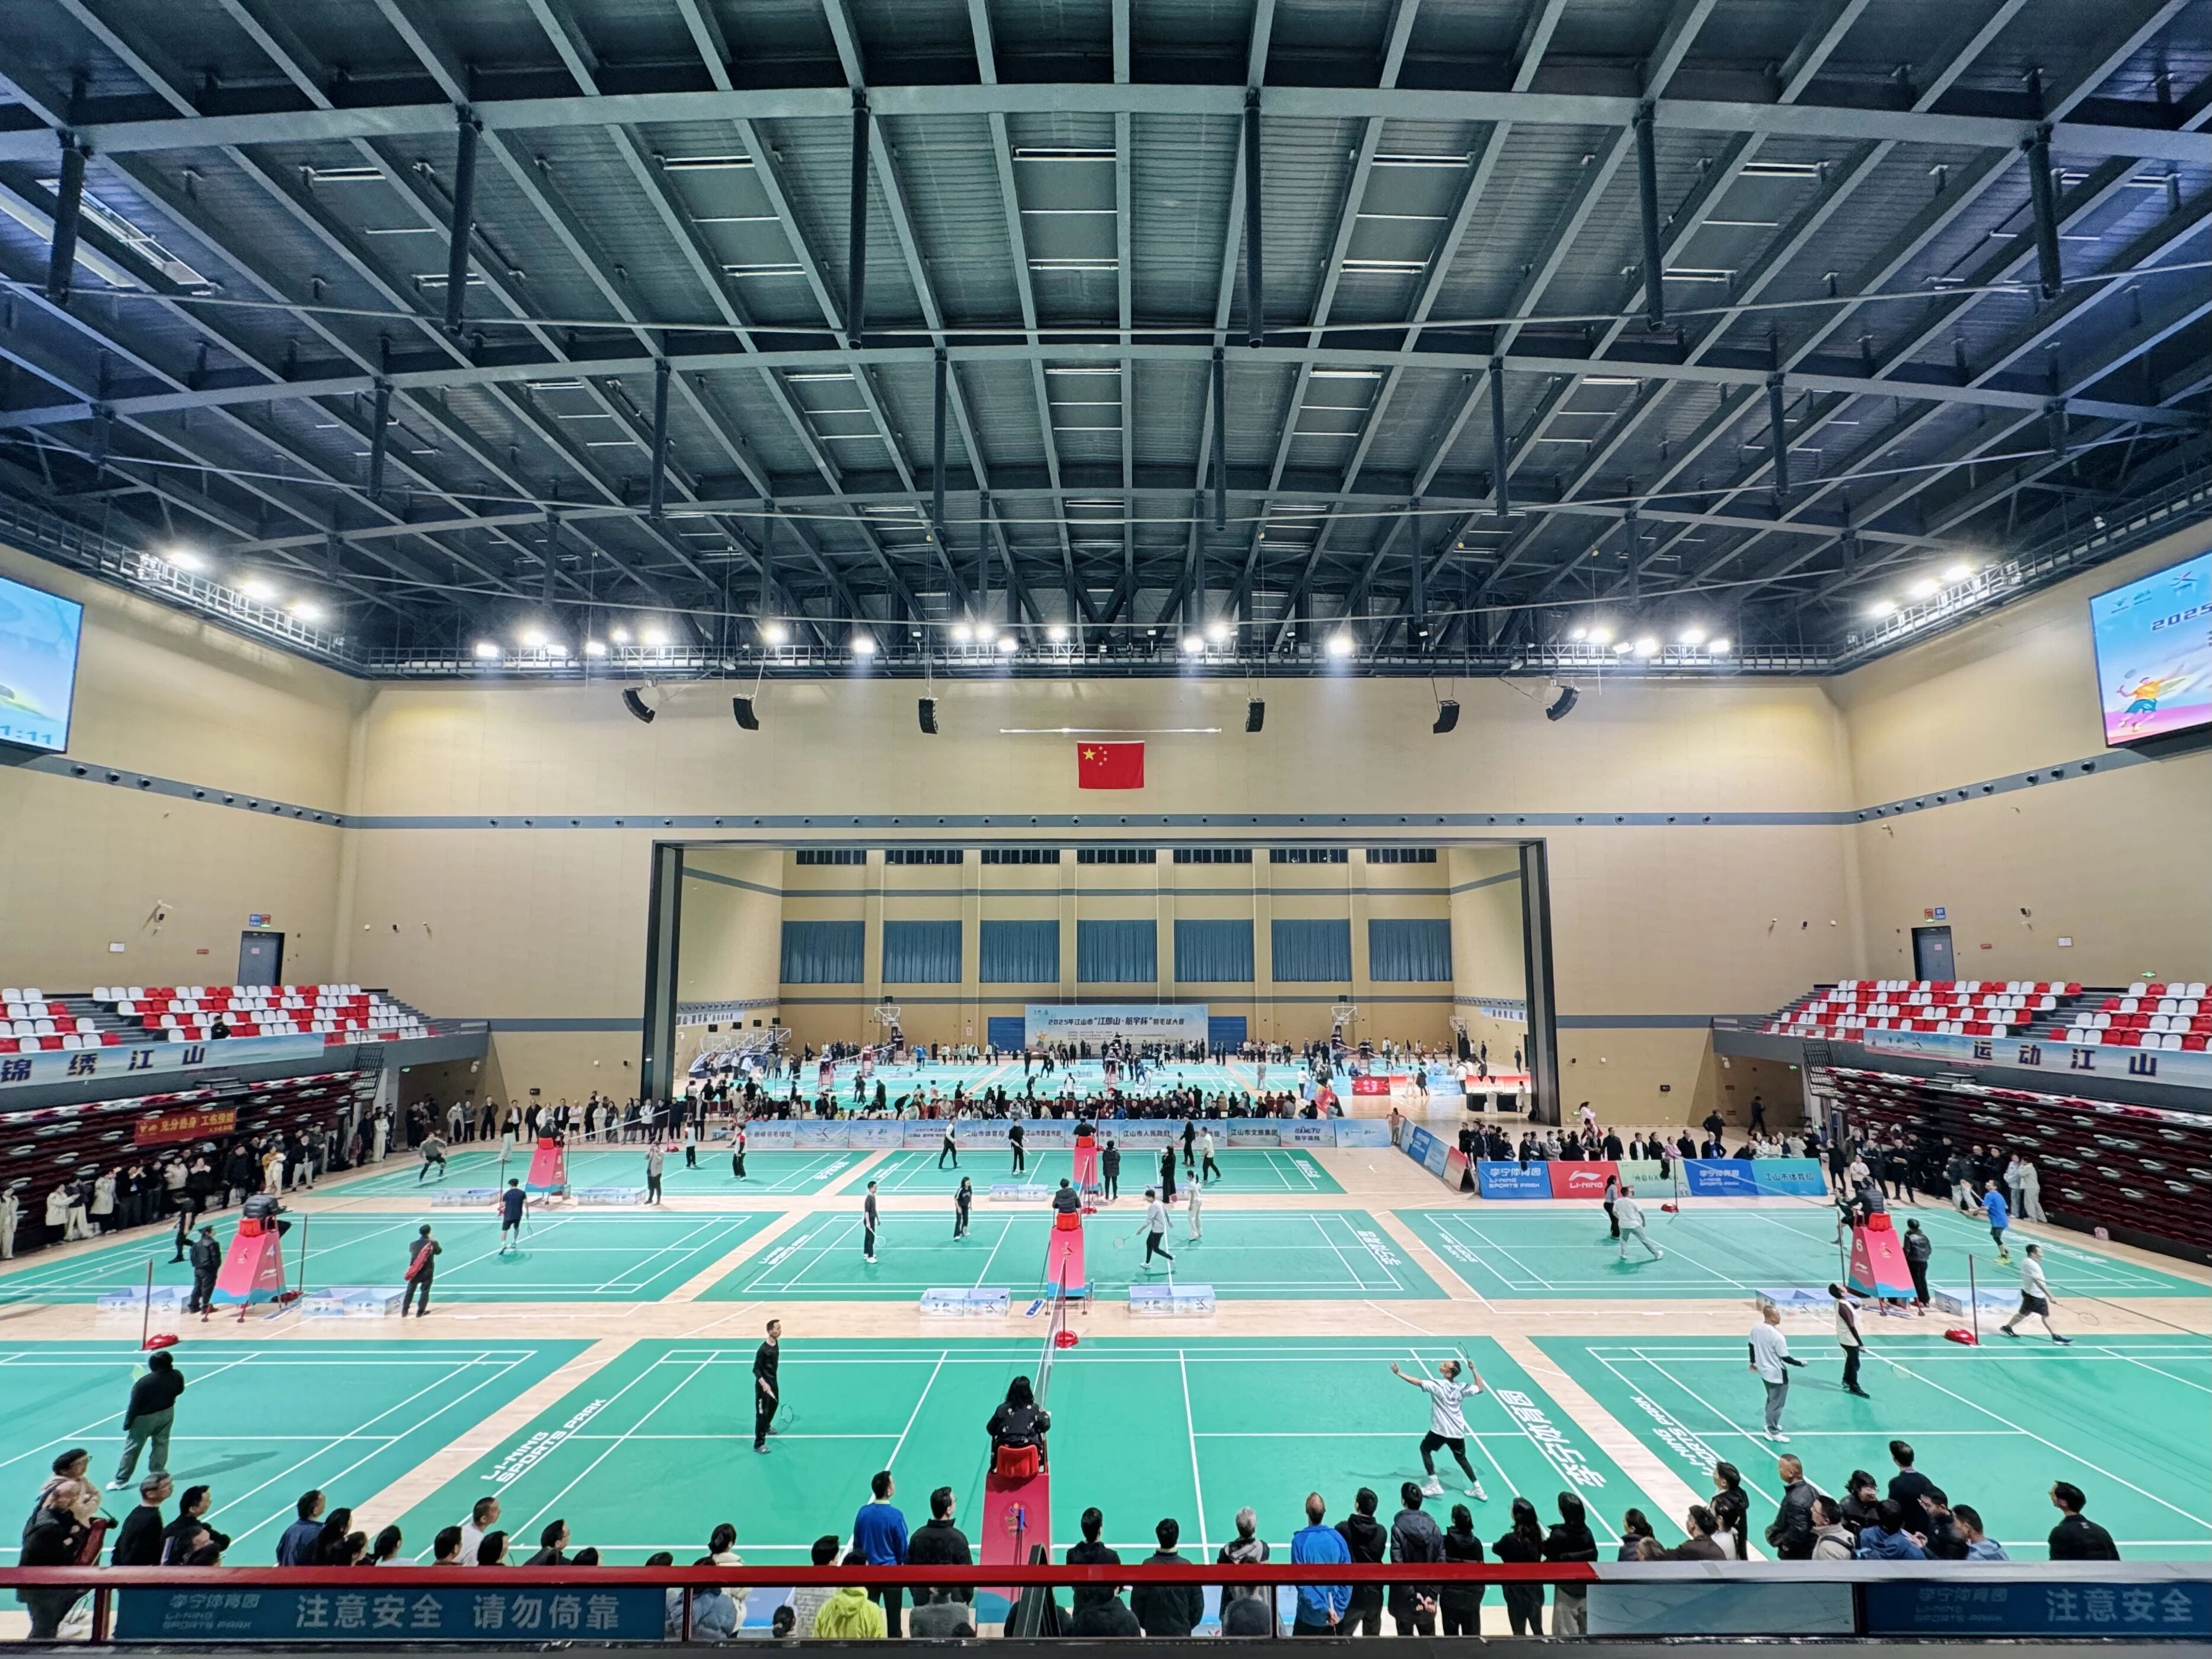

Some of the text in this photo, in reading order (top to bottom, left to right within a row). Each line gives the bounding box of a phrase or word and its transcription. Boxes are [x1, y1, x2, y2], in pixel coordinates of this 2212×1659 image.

[1, 1045, 205, 1082] 锦绣江山
[1973, 1041, 2157, 1076] 运动江山
[1764, 1173, 1814, 1182] 江山市体育局
[266, 1244, 275, 1257] 4
[1856, 1238, 1863, 1252] 6
[496, 1399, 607, 1483] SPORTS PARK
[1496, 1389, 1607, 1488] 李宁体育园
[1630, 1396, 1718, 1469] PORTS PARK
[480, 1431, 550, 1481] LI-NING
[169, 1594, 261, 1609] 李宁体育园
[296, 1594, 620, 1630] 注意安全 请勿倚靠
[2047, 1588, 2193, 1622] 注意安全
